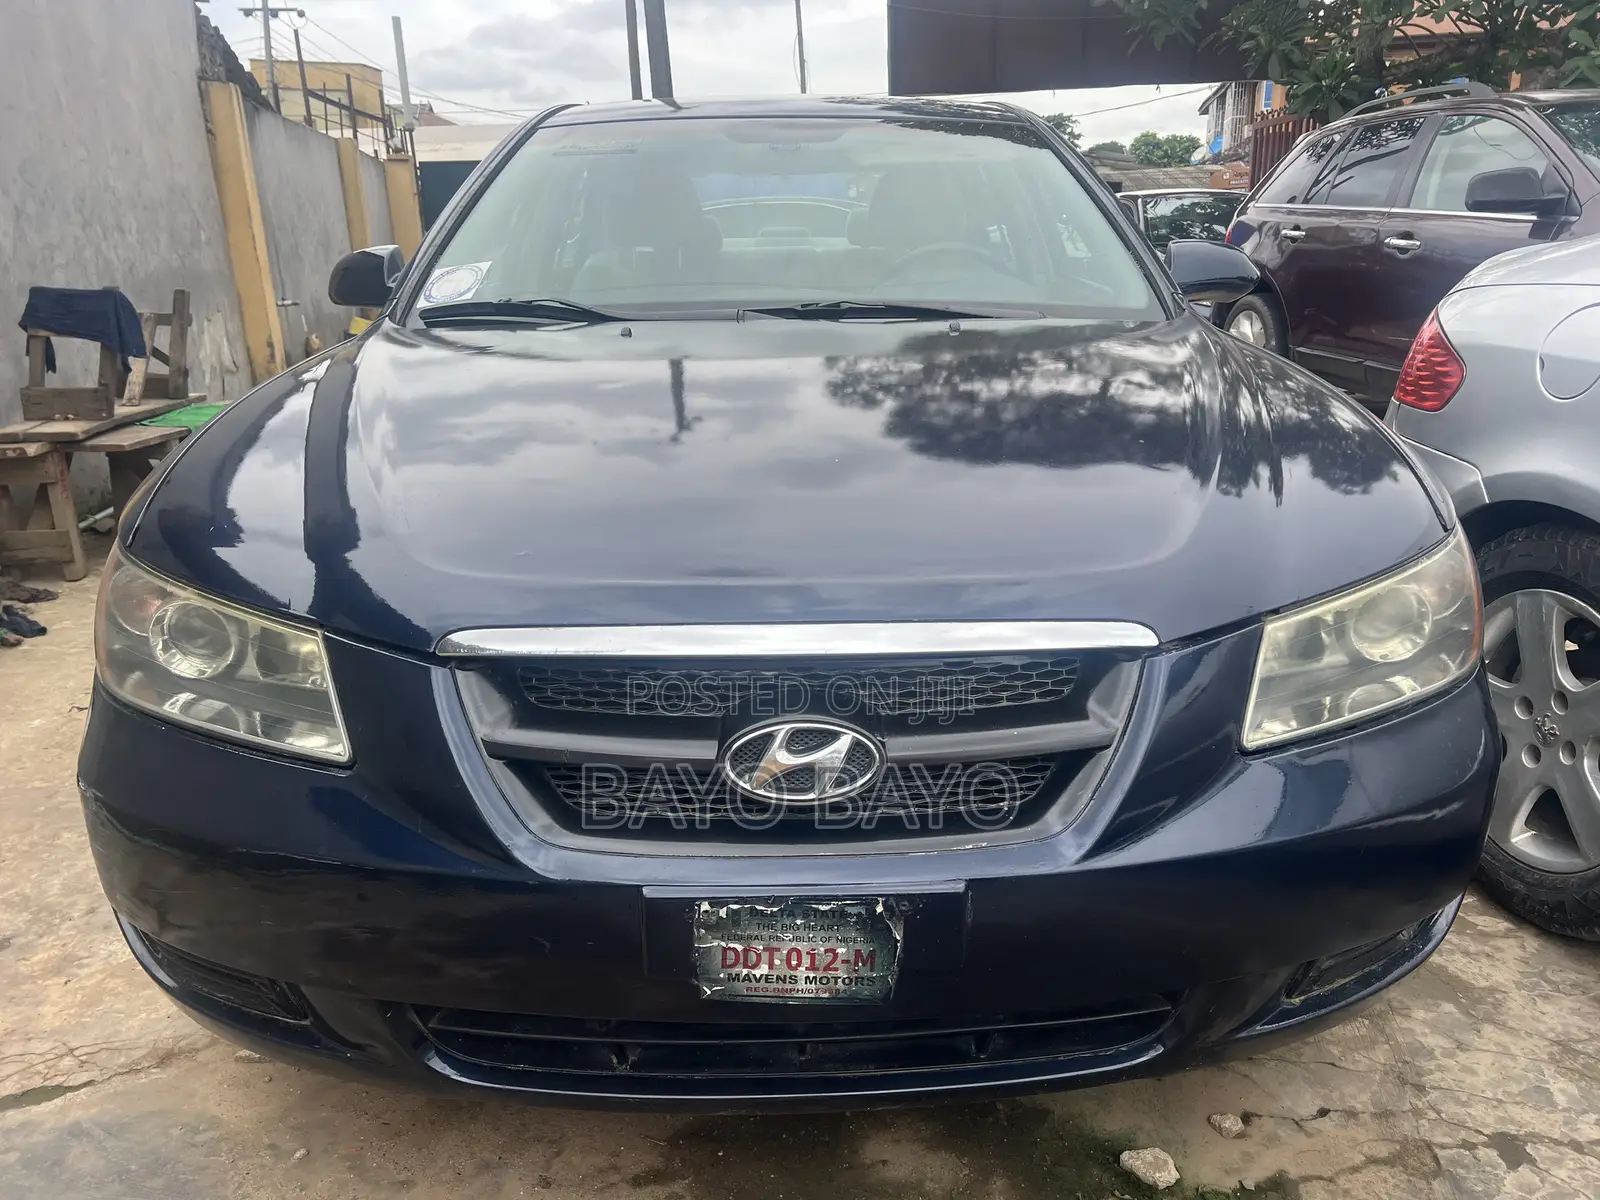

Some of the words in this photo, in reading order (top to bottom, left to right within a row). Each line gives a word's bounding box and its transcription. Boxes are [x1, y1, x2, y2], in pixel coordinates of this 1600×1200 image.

[756, 922, 777, 931] THE
[781, 923, 799, 932] BIG
[803, 924, 841, 933] HEART
[721, 933, 767, 942] FEDERAL
[836, 935, 876, 944] NIGERIA
[727, 973, 798, 984] MAVENS
[804, 975, 876, 986] MOTORS
